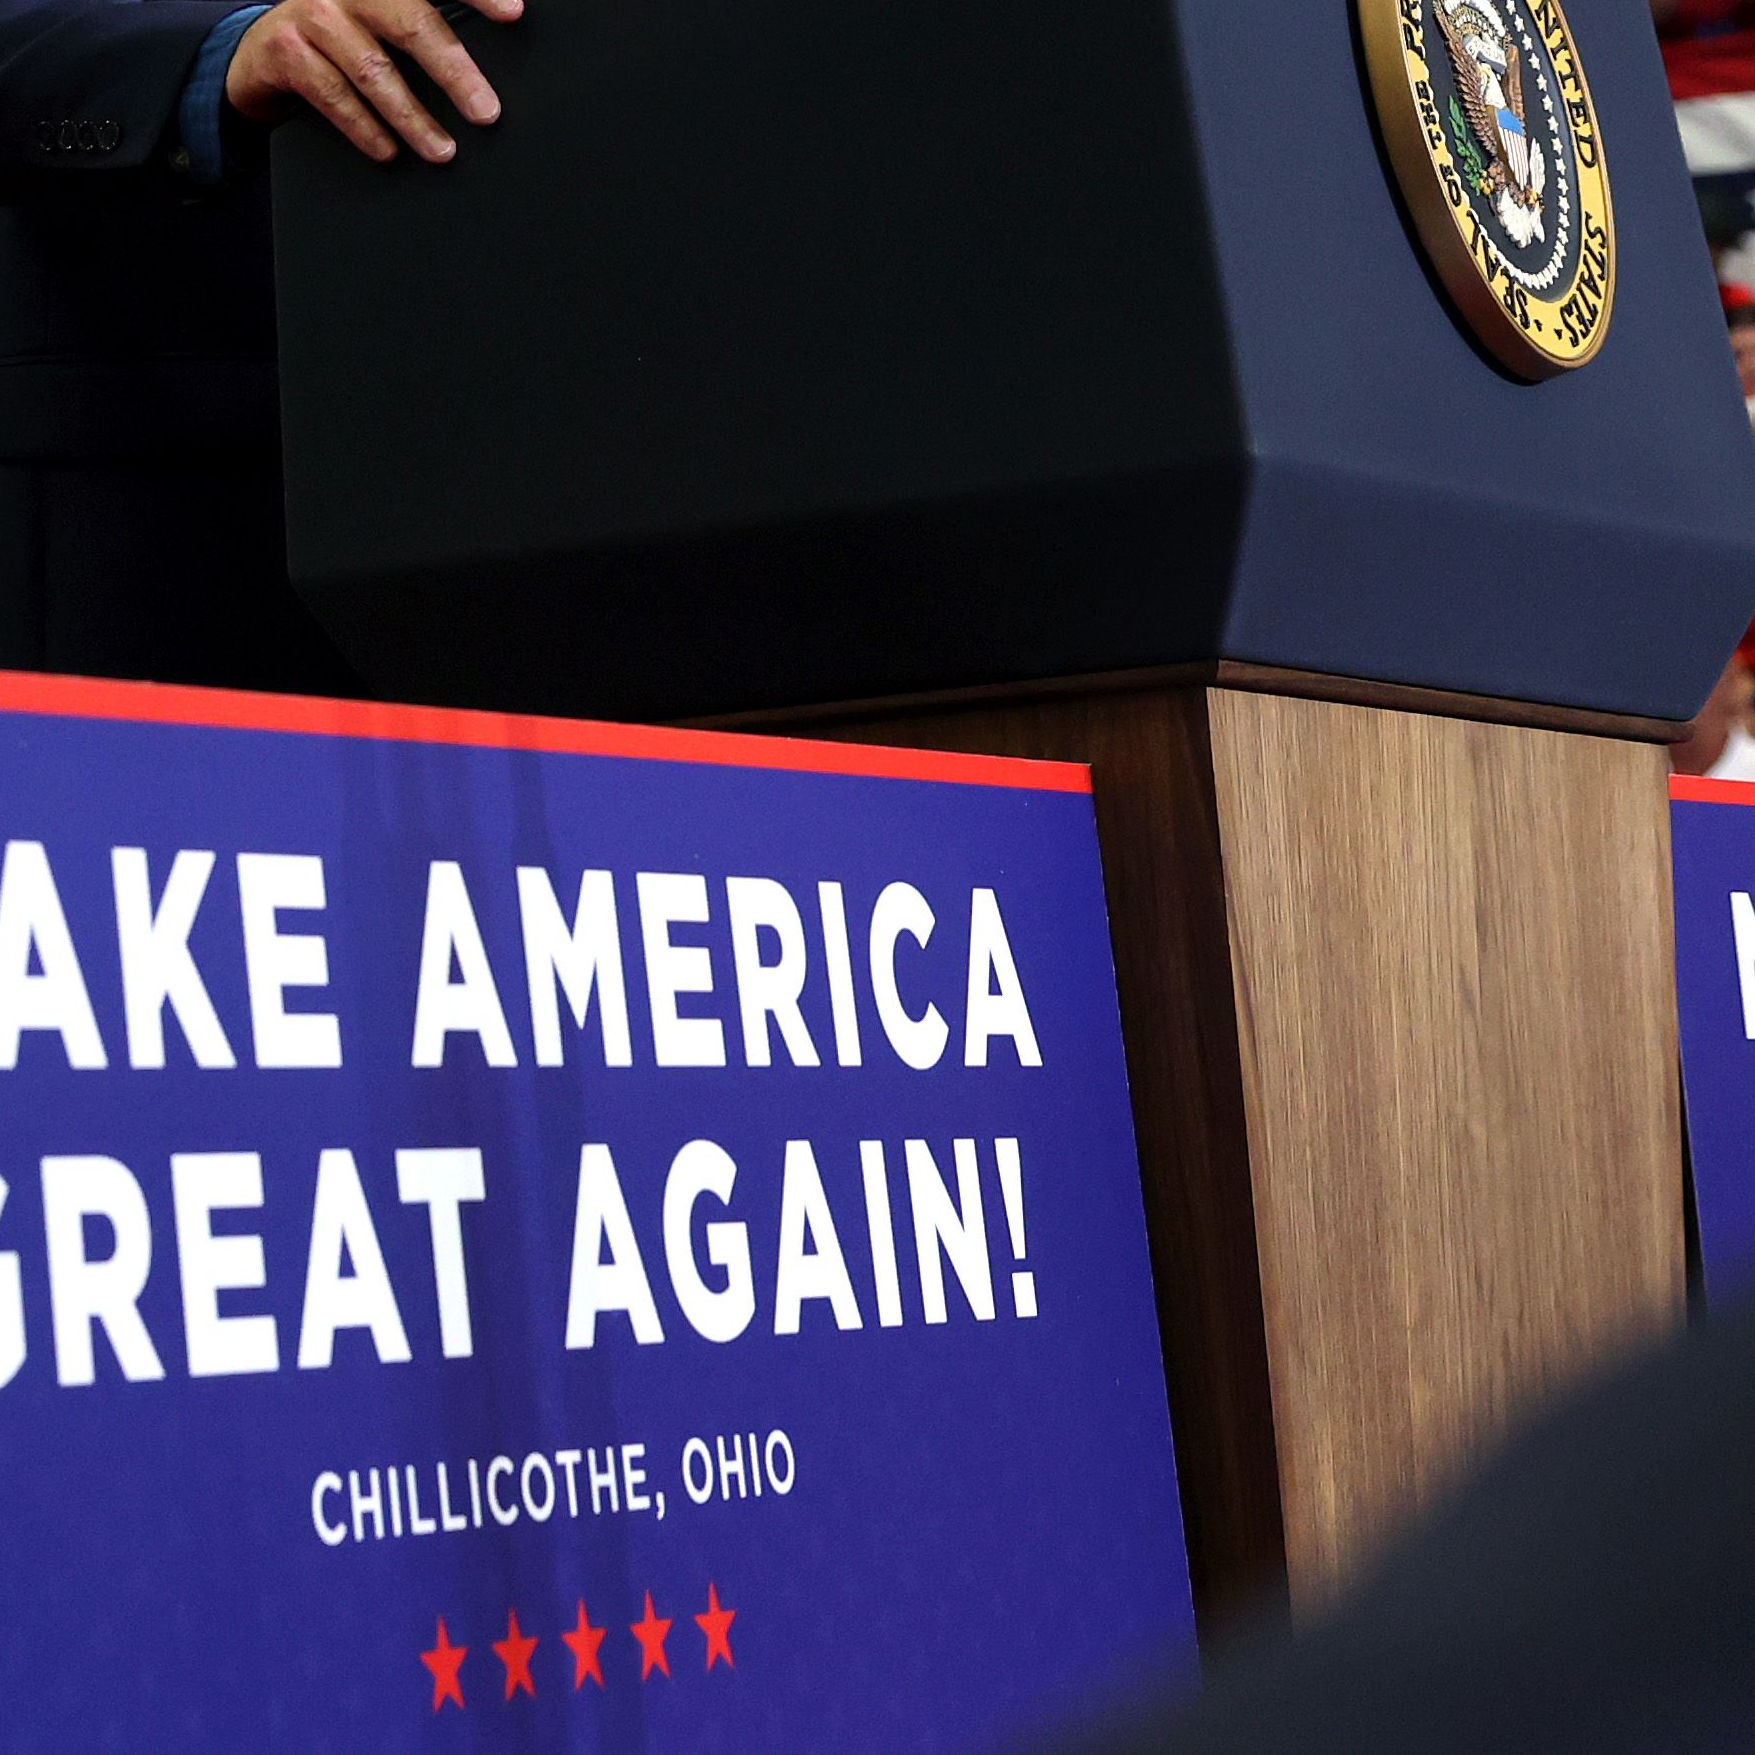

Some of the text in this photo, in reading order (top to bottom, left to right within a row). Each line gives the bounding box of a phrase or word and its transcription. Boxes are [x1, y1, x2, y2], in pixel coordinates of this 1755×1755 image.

[1466, 209, 1531, 330] SEAL
[1559, 210, 1608, 348] STATES
[411, 860, 1044, 1070] AMERICA
[565, 1137, 1039, 1350] AGAIN!
[311, 1429, 796, 1546] CHILLICOTHE, OHIO
